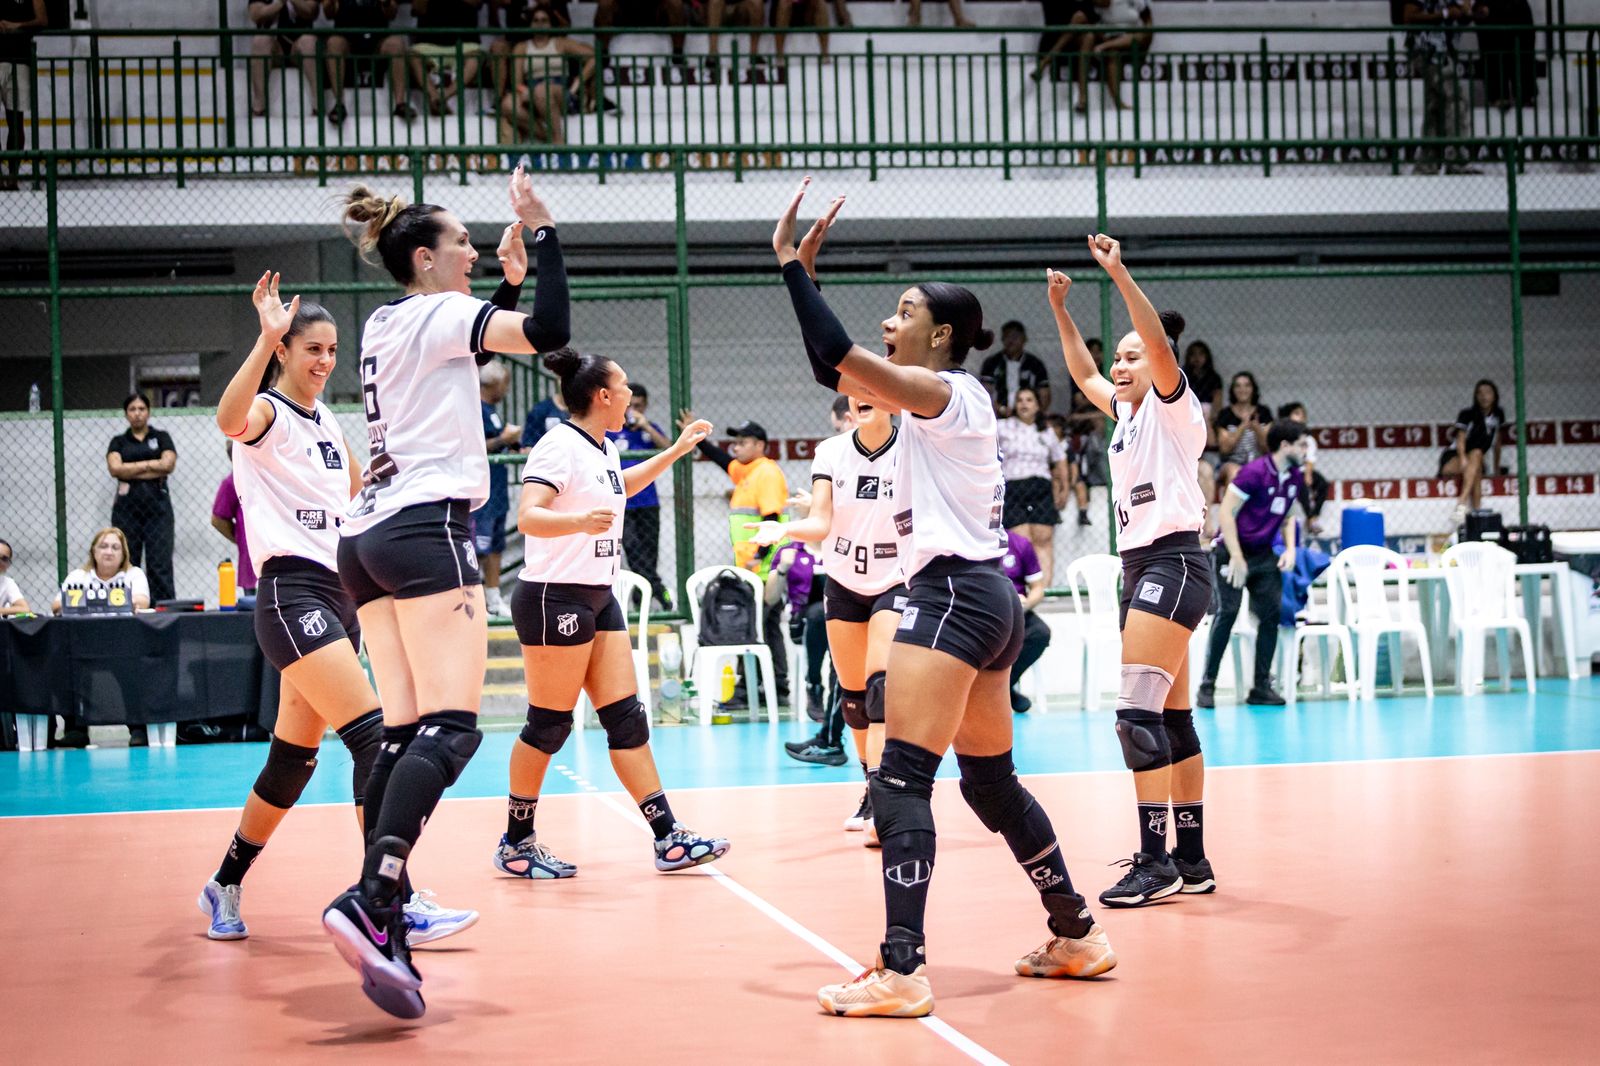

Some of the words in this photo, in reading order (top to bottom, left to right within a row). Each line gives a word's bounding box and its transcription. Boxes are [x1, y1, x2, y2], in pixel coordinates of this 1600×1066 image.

[1319, 429, 1331, 445] C
[1339, 428, 1359, 445] 20
[1382, 428, 1396, 444] C
[1405, 427, 1422, 442] 19
[1351, 482, 1365, 498] B
[1373, 481, 1393, 498] 17
[1415, 480, 1429, 497] B
[1436, 480, 1458, 497] 16
[1544, 477, 1557, 493] B
[1565, 476, 1585, 493] 14
[854, 545, 867, 575] 9
[68, 589, 83, 607] 7
[110, 588, 126, 606] 6
[1178, 811, 1194, 821] G
[1030, 865, 1052, 881] G
